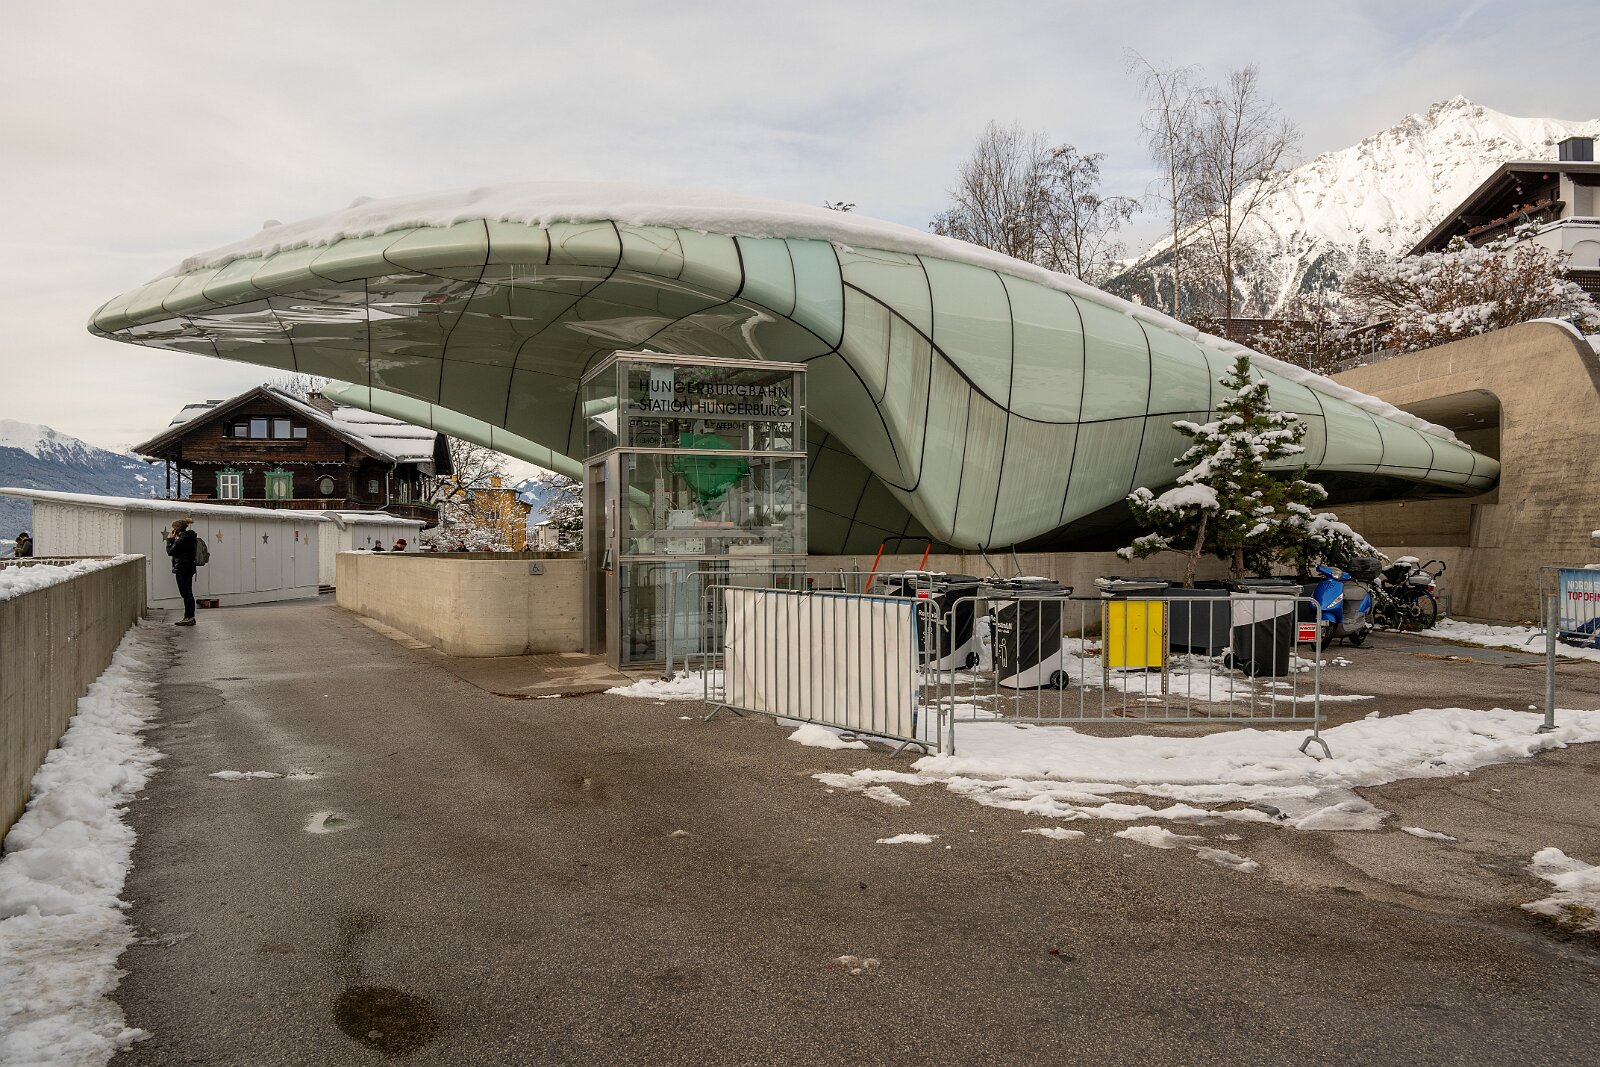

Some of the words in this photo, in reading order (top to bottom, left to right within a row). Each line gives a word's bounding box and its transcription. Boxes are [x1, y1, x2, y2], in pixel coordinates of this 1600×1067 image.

[639, 378, 788, 399] HUNGERBURGBAHN
[639, 397, 693, 414] STATION
[697, 401, 790, 418] HUNGERBURG
[1567, 590, 1583, 601] TOP
